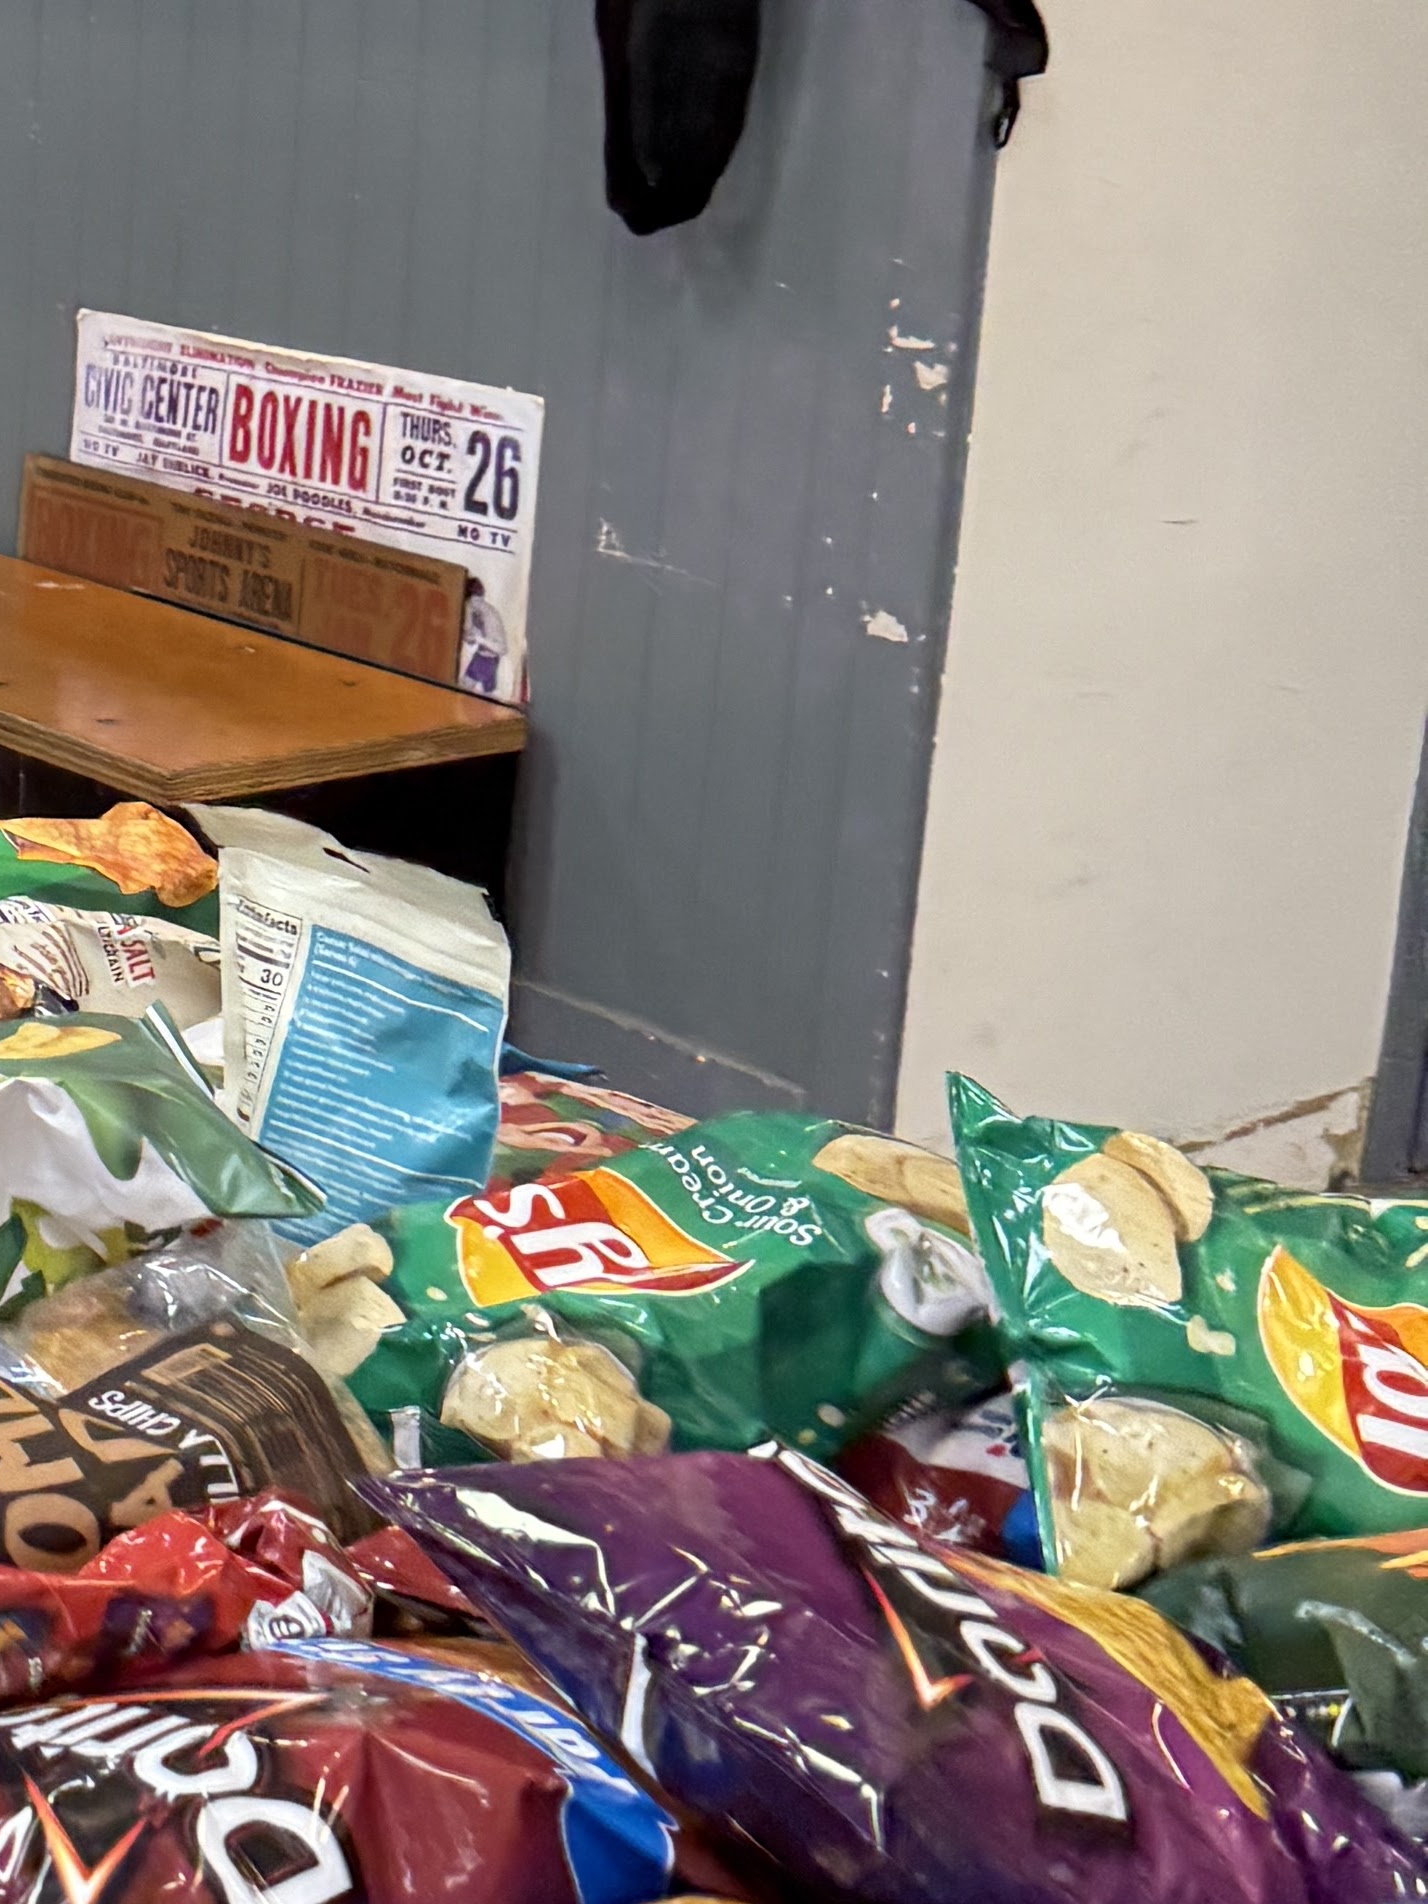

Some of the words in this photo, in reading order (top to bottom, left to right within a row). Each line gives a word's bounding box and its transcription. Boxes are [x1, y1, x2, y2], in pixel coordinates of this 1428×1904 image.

[85, 363, 133, 412] CIVIC
[142, 372, 220, 436] CENTER
[329, 372, 383, 396] FRAZIER
[228, 383, 372, 494] BOXING
[400, 412, 457, 448] THURS.
[401, 445, 453, 475] OCT.
[463, 428, 523, 522] 26
[103, 445, 120, 458] TV
[457, 523, 481, 542] NO
[490, 531, 512, 548] TV
[164, 547, 230, 602] SPORTS
[120, 938, 155, 987] SALT
[260, 969, 284, 987] 30
[88, 1389, 182, 1445] CHIPS
